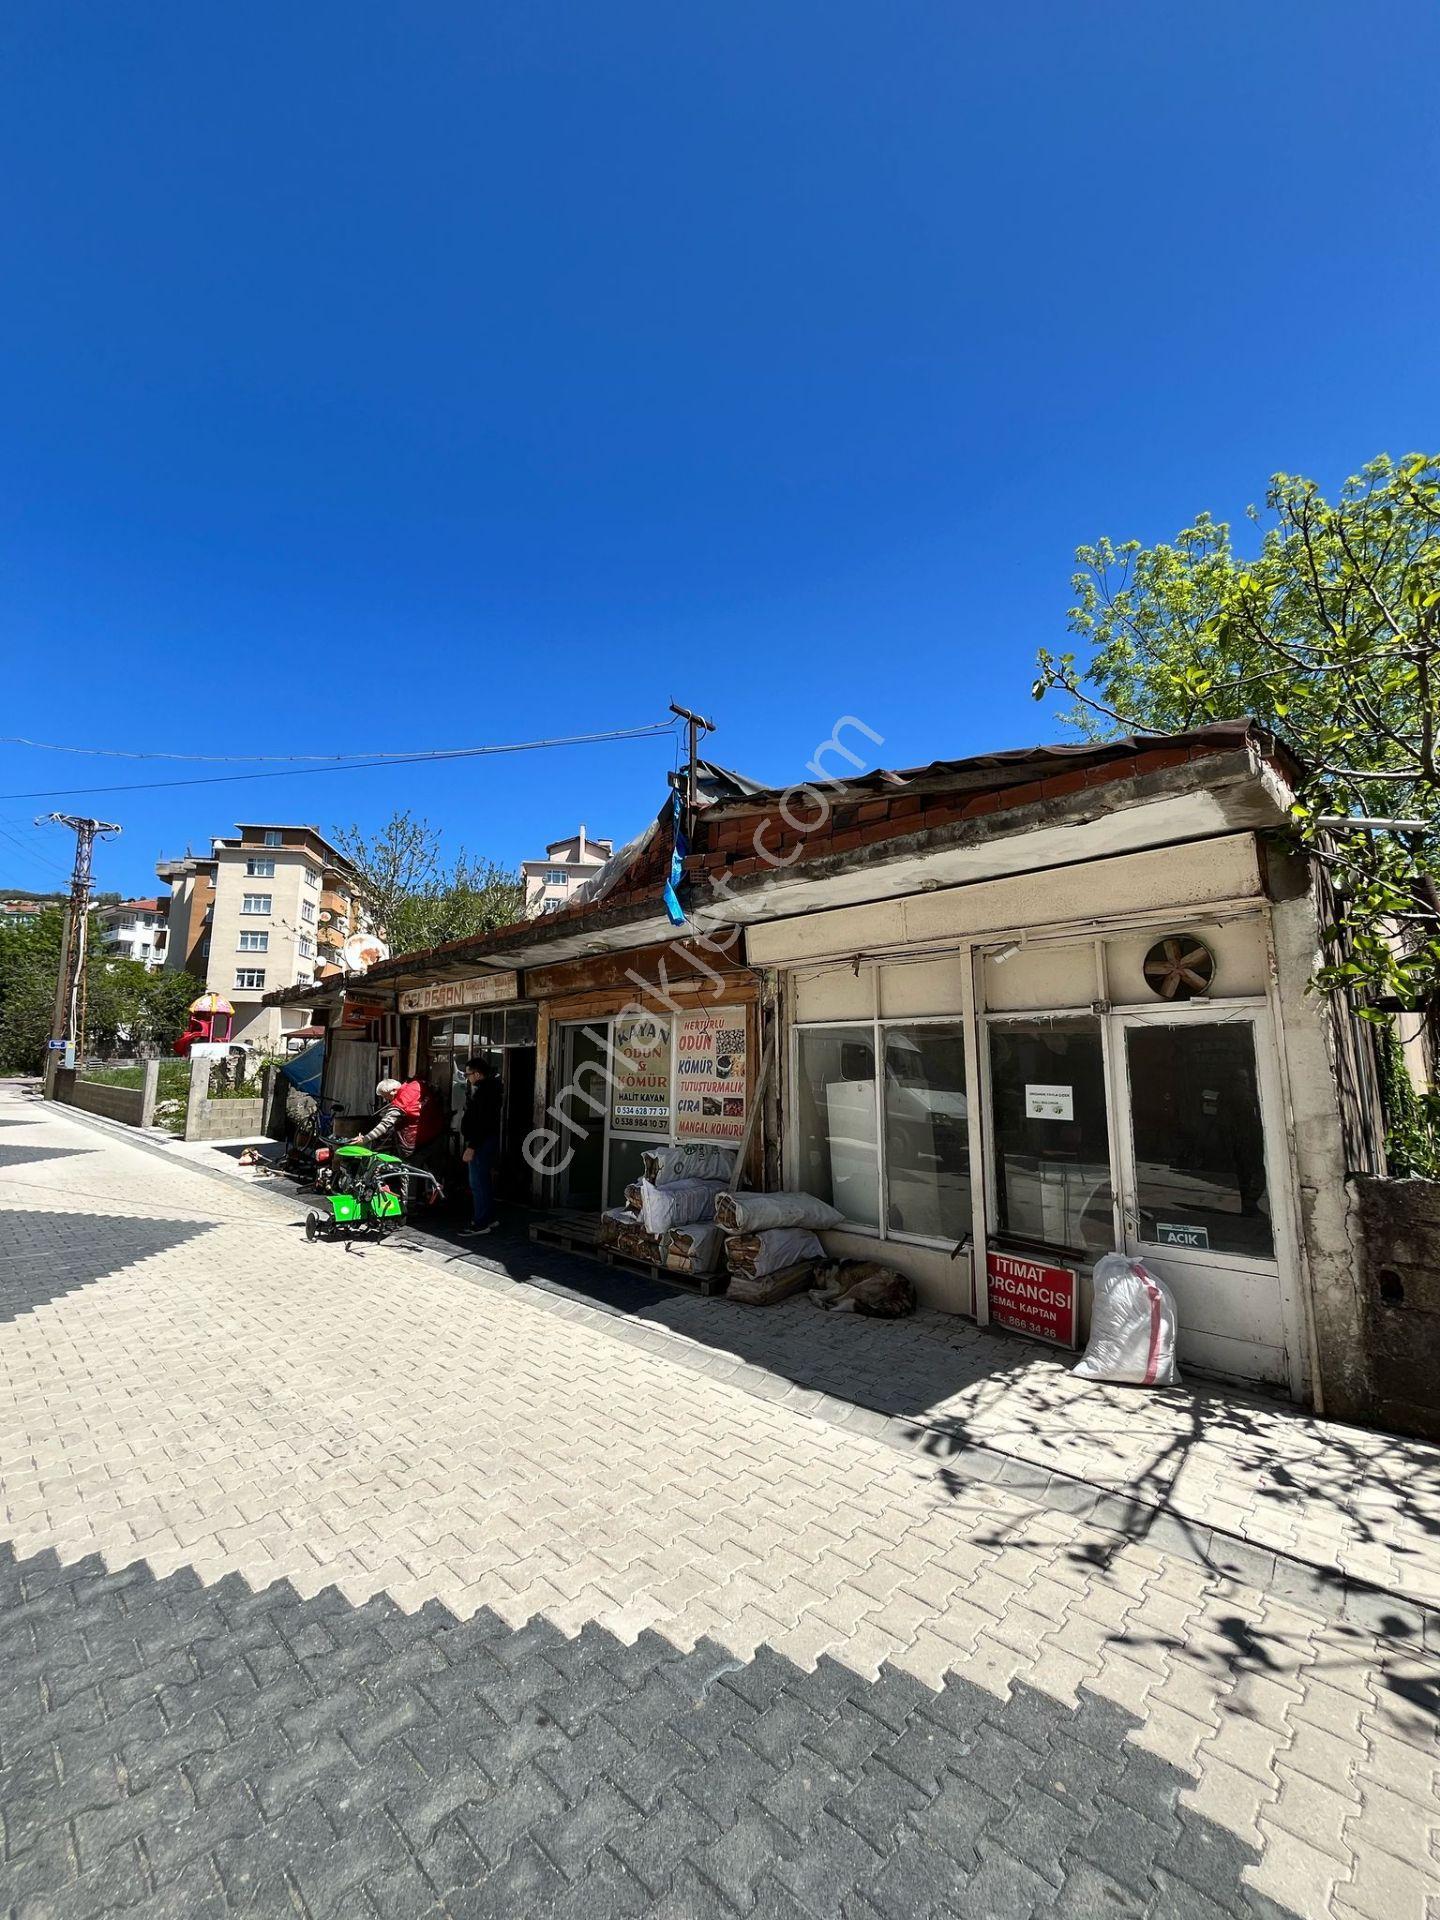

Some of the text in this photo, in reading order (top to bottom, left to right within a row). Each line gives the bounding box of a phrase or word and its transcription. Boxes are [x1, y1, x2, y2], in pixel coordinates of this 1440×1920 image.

[617, 1023, 670, 1046] KAYAN
[679, 1034, 712, 1051] ODUN
[624, 1047, 662, 1058] ODUN
[678, 1056, 713, 1075] KÖMÜR
[618, 1073, 667, 1087] KÖMÜR
[640, 1094, 665, 1102] KAYAN
[678, 1099, 700, 1114] ÇIRA
[679, 1120, 708, 1133] MANGAL
[987, 1273, 1071, 1310] ORGANCISI
[1019, 1302, 1057, 1321] KAPTAN
